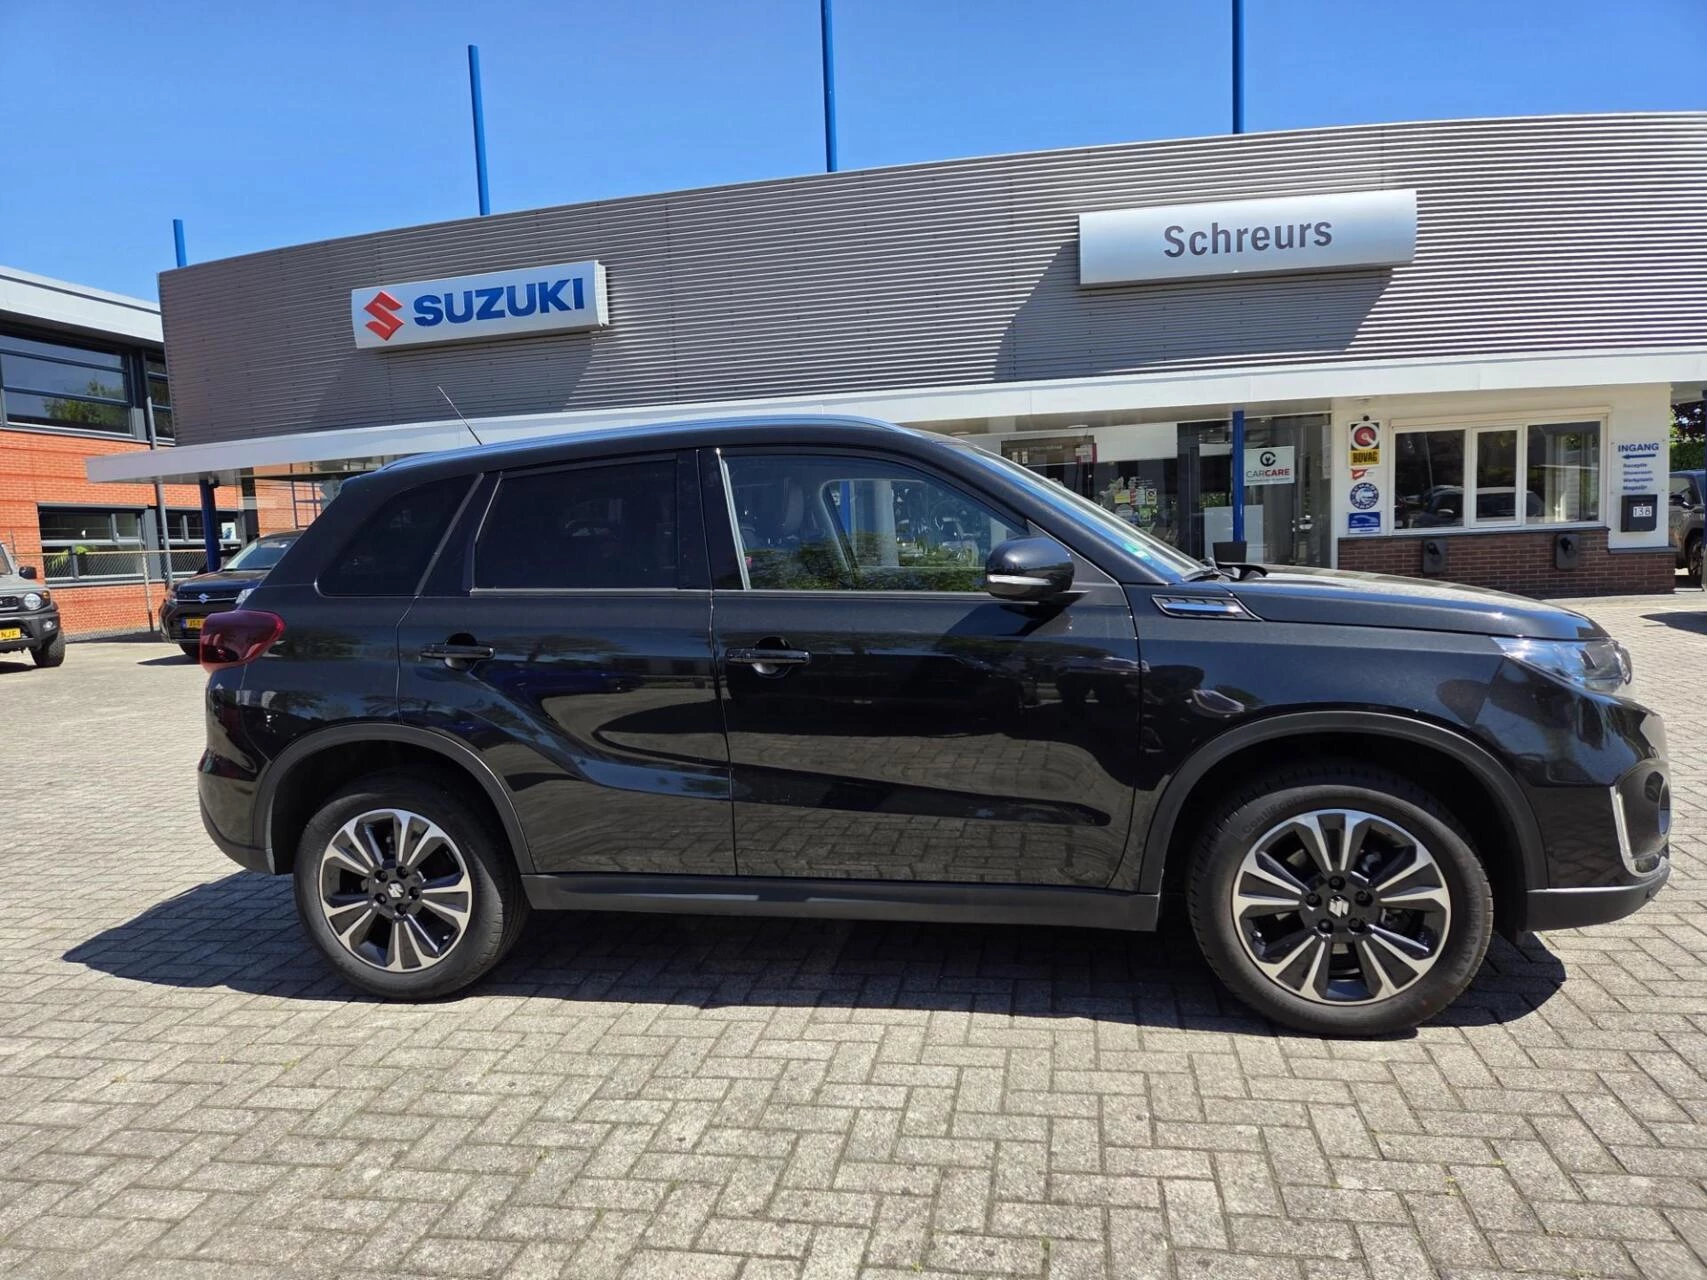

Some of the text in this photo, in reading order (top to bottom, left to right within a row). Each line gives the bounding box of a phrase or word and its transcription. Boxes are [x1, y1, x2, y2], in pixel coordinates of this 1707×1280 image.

[1163, 221, 1333, 258] Schreurs
[413, 278, 584, 327] SUZUKI
[1618, 443, 1659, 452] INGANG
